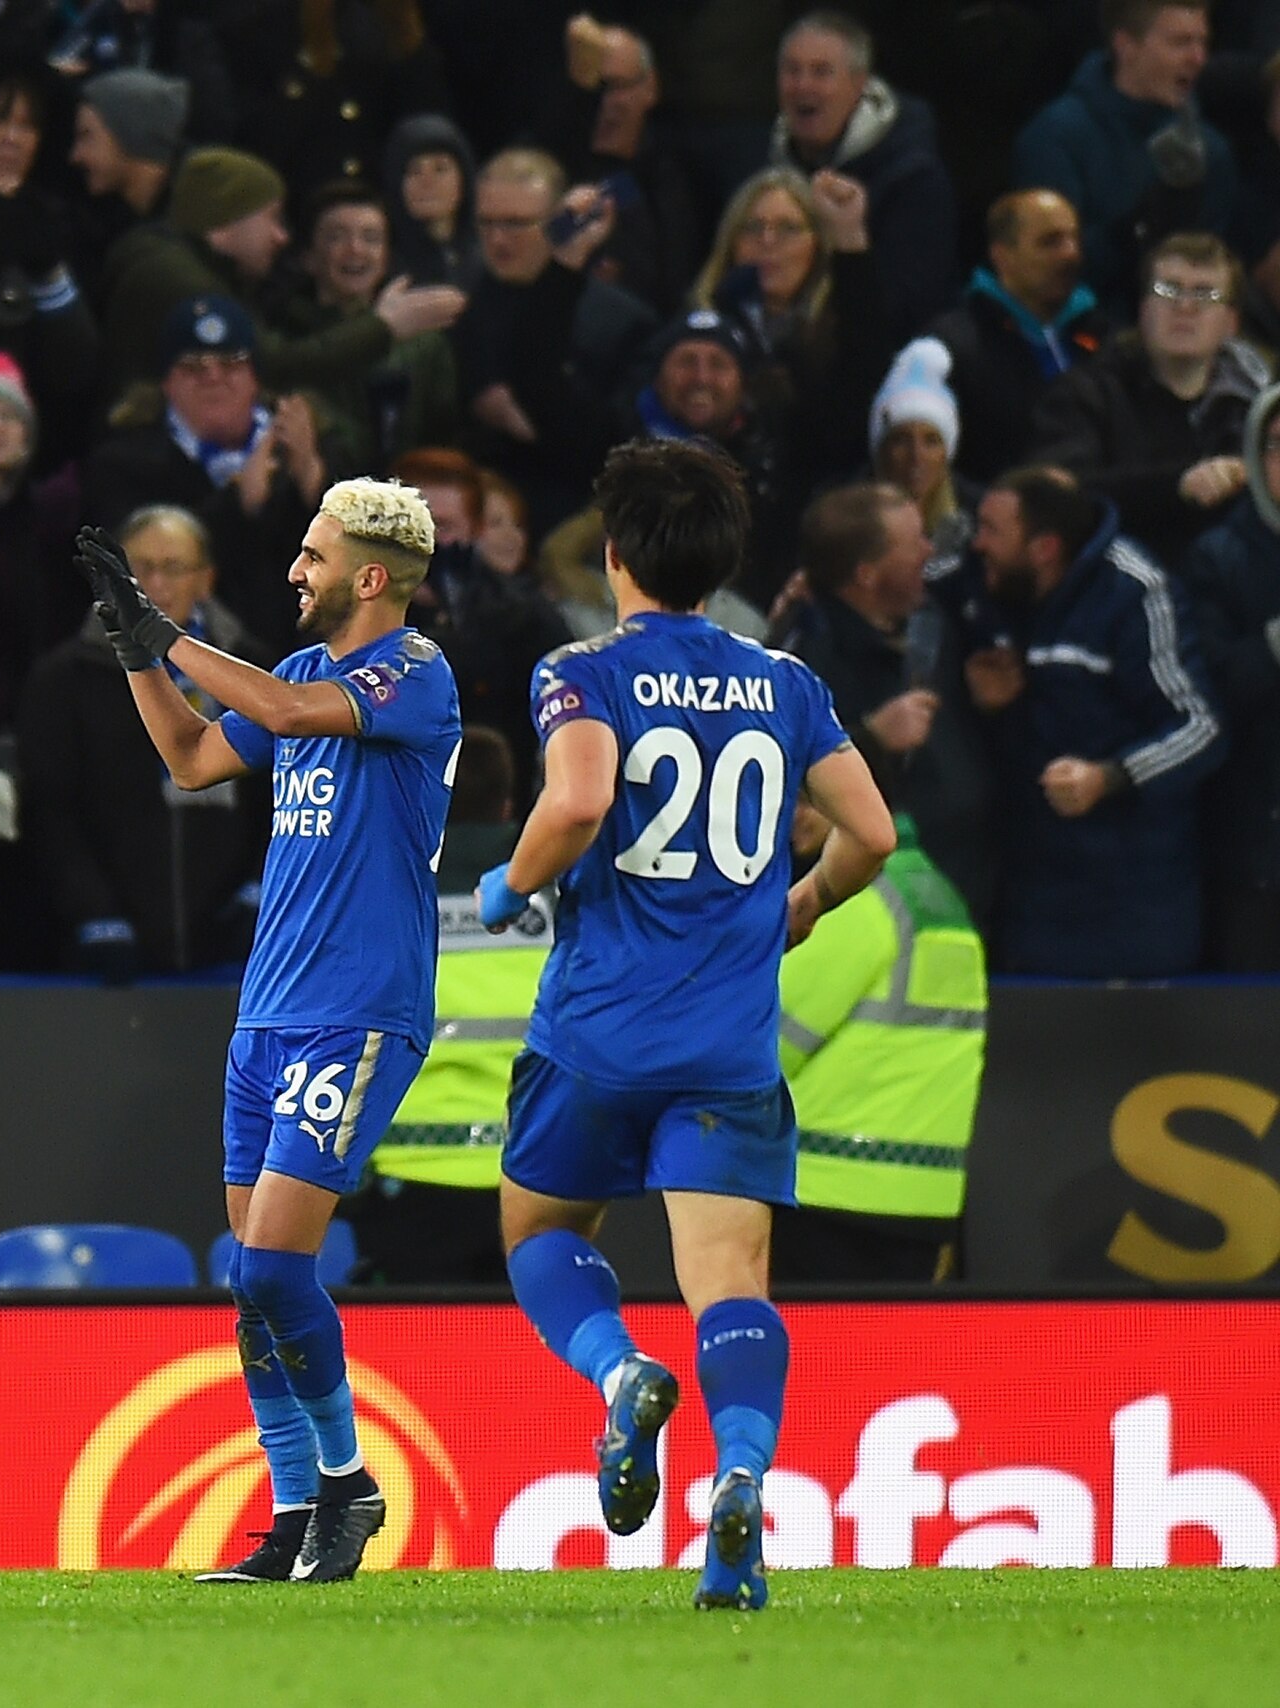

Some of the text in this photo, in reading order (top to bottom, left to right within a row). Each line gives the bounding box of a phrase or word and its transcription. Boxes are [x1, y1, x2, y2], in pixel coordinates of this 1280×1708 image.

[633, 672, 775, 713] OKAZAKI
[271, 808, 333, 838] OWER
[614, 726, 785, 886] 20
[274, 1060, 344, 1122] 26
